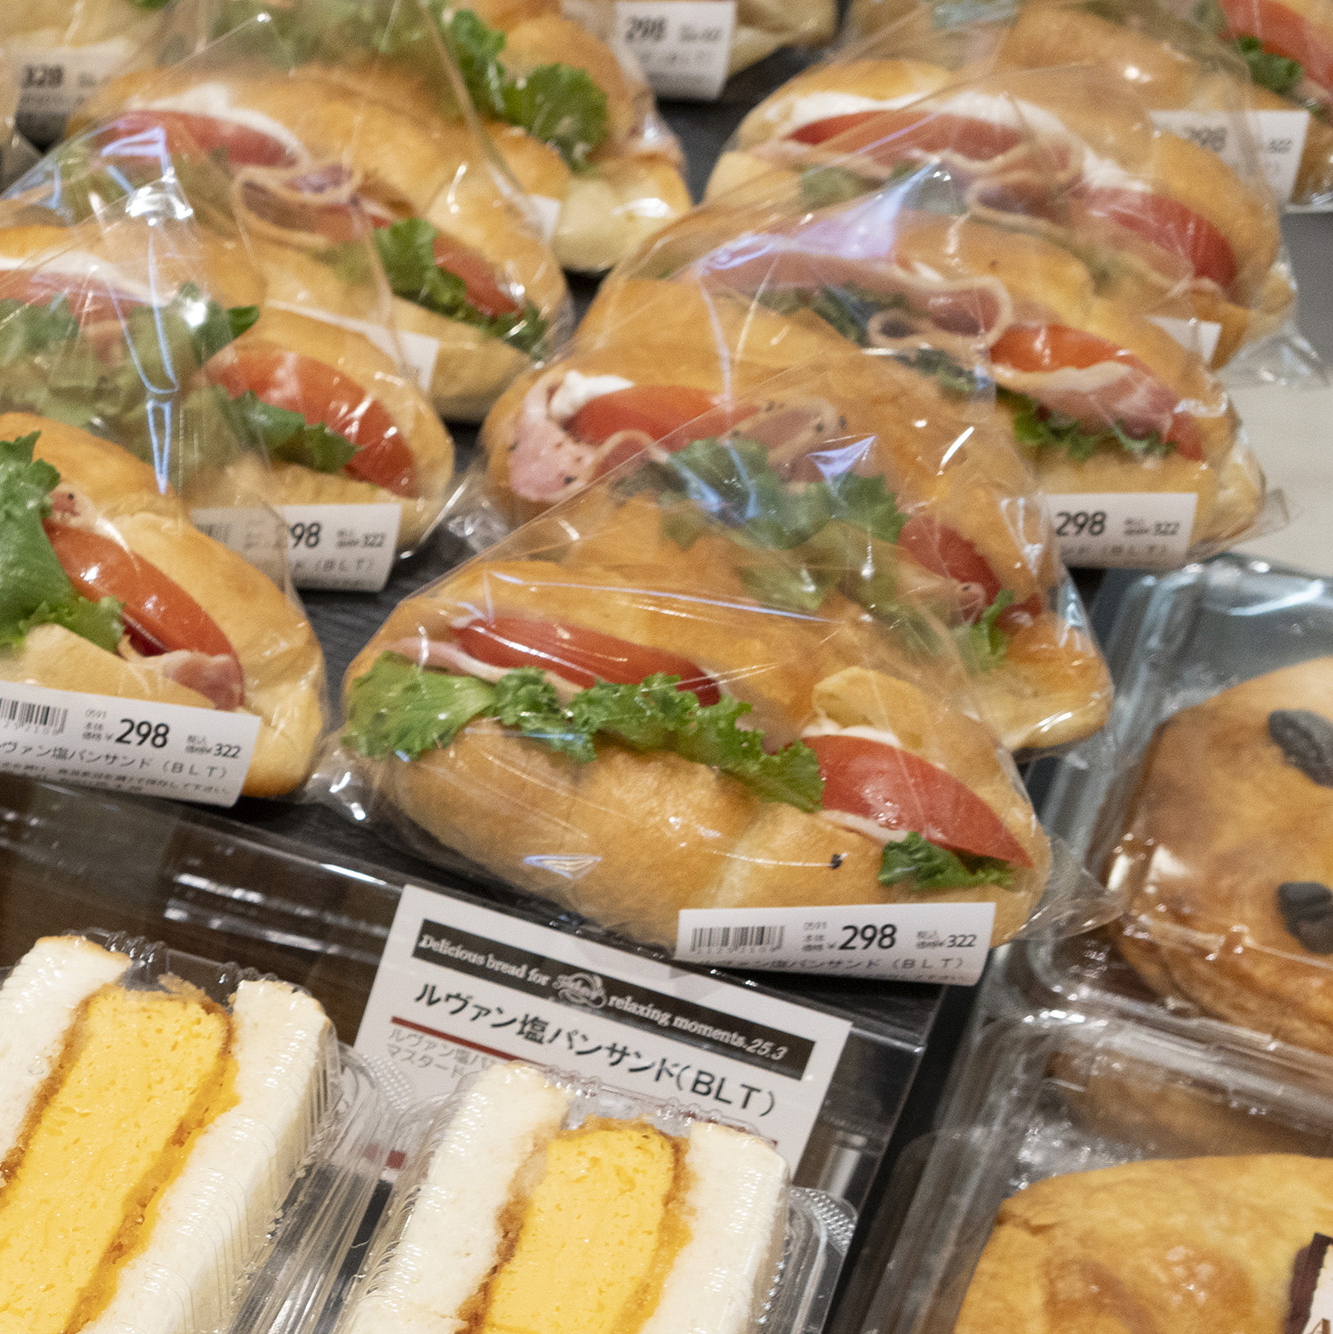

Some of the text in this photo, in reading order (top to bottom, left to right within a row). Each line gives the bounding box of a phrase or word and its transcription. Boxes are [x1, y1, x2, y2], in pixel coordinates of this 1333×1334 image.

[1056, 511, 1107, 536] 298
[115, 718, 169, 749] 298
[839, 924, 977, 950] 298 322
[419, 934, 485, 968] Delicious
[486, 953, 526, 979] bread
[527, 968, 550, 987] for
[607, 992, 672, 1028] relaxing
[414, 982, 778, 1118] ルヴァン塩パンサンド(BLT)
